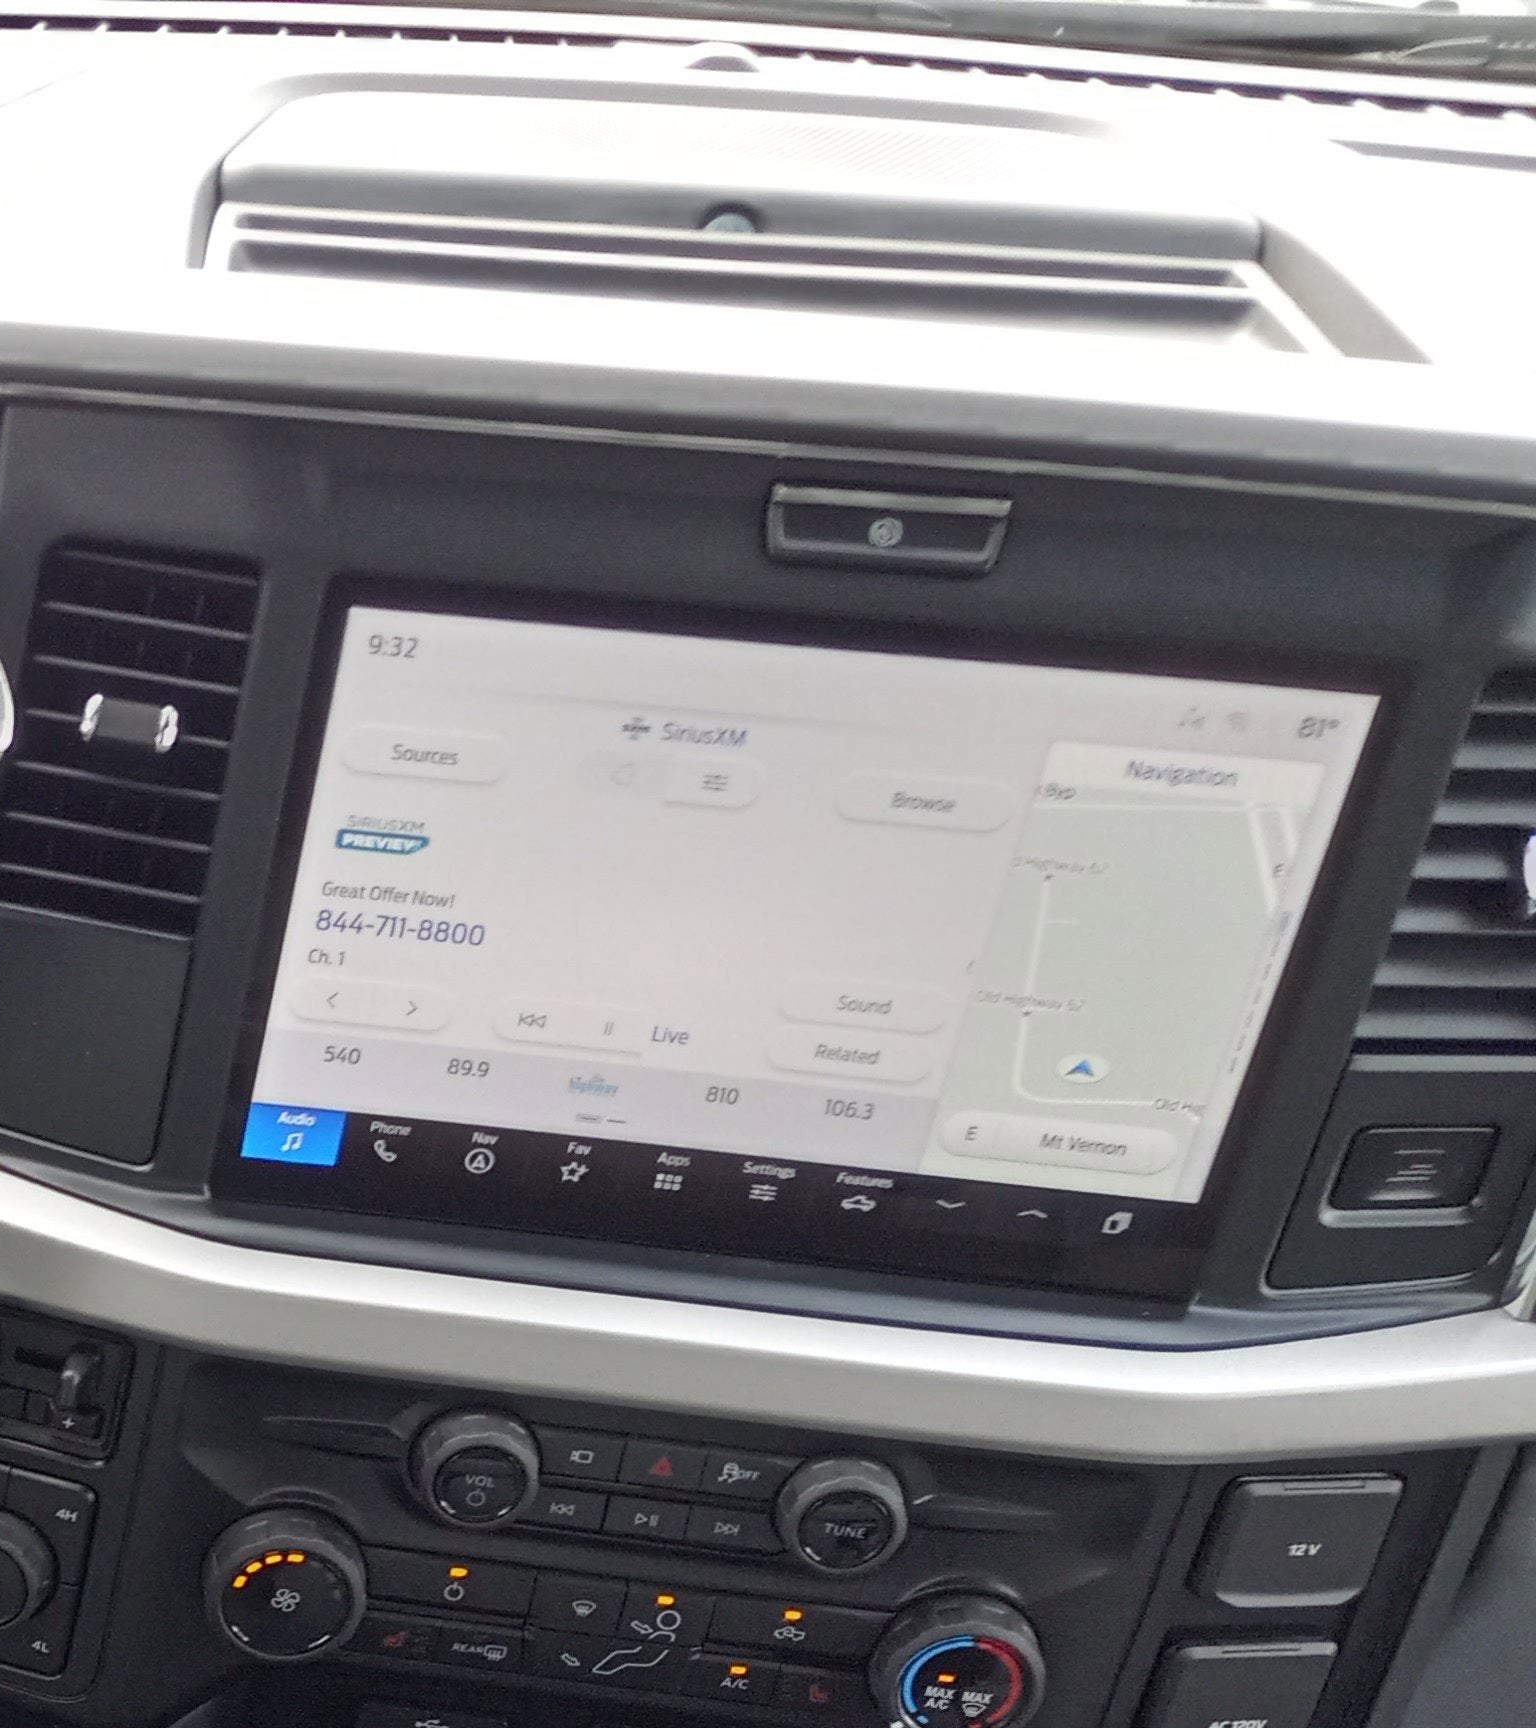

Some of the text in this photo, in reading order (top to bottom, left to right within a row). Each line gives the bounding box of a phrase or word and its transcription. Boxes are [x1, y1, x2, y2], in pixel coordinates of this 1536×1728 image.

[367, 633, 419, 659] 9:32
[660, 722, 749, 747] SiriusXM
[390, 743, 459, 767] Sources
[1125, 759, 1240, 787] Navigation
[890, 790, 958, 814] Browse
[347, 813, 426, 833] SIRIUSXM
[322, 881, 456, 909] Great Offer Now!
[315, 909, 486, 946] 844-711-8800
[307, 948, 346, 966] Ch. 1
[835, 994, 894, 1015] Sound
[650, 1025, 690, 1045] Live
[323, 1045, 362, 1066] 540
[814, 1043, 881, 1066] Related
[446, 1057, 491, 1079] 89.9
[704, 1085, 740, 1106] 810
[276, 1110, 318, 1128] Audio
[824, 1098, 875, 1121] 106.3
[369, 1119, 412, 1138] Phone
[964, 1125, 978, 1141] E
[471, 1131, 500, 1147] Nav
[1038, 1132, 1128, 1156] Mt Vernon
[566, 1141, 592, 1158] Fav
[656, 1151, 692, 1168] Apps
[741, 1161, 797, 1180] Settings
[835, 1171, 896, 1189] Features
[465, 1473, 496, 1490] VOL
[737, 1470, 760, 1481] OFF
[55, 1507, 79, 1524] 4H
[824, 1522, 868, 1541] TUNE
[31, 1639, 51, 1655] 4L
[449, 1642, 485, 1654] REAR
[719, 1676, 750, 1690] A/C
[923, 1685, 956, 1700] MAX
[961, 1691, 995, 1705] MAX
